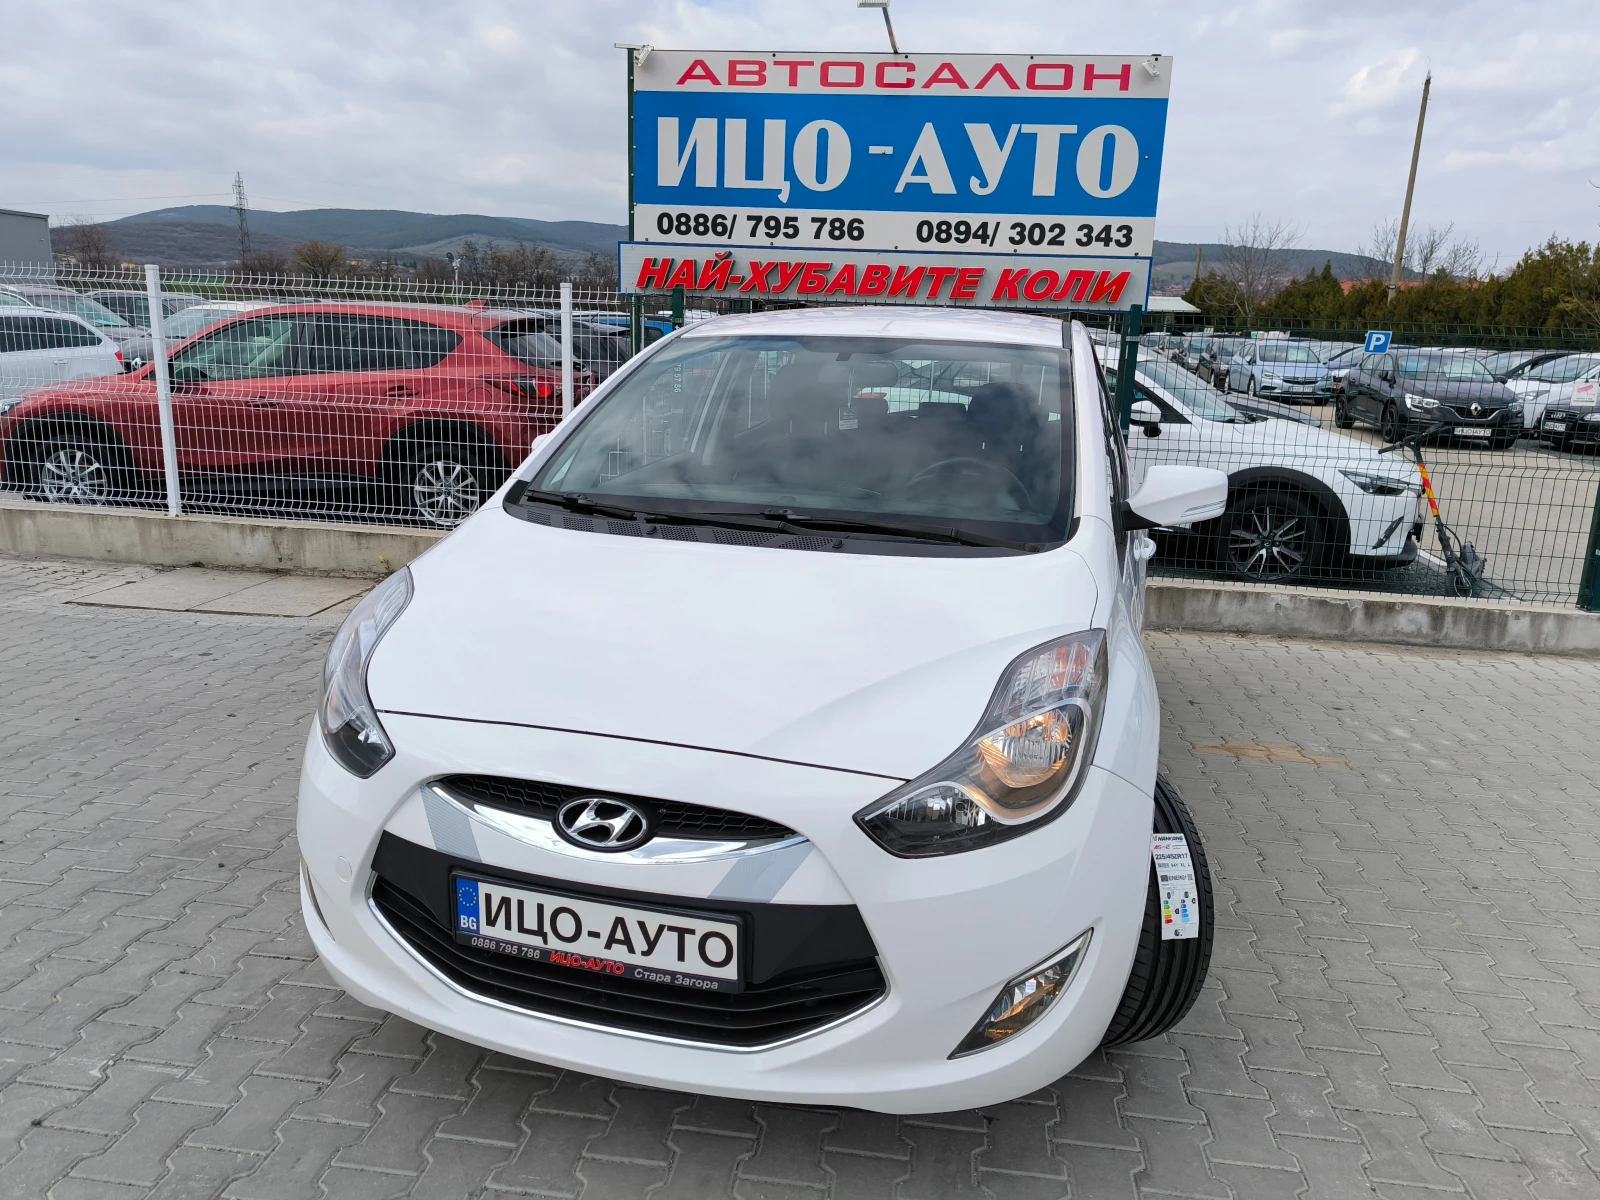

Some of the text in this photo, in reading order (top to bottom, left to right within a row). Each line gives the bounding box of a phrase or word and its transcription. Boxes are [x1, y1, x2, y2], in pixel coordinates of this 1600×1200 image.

[677, 60, 1132, 92] АВТОСАЛОН
[656, 212, 1133, 248] 0886/ 795 786 0894/ 302 343
[635, 252, 1132, 303] НАЙ-ХУБАВИТЕ КОЛИ
[1369, 334, 1386, 351] P
[460, 915, 477, 930] BG
[484, 892, 734, 969] ИЦО-АУТО
[471, 937, 719, 990] 0886 795 786 ИЦО-АУТО Стара Загора
